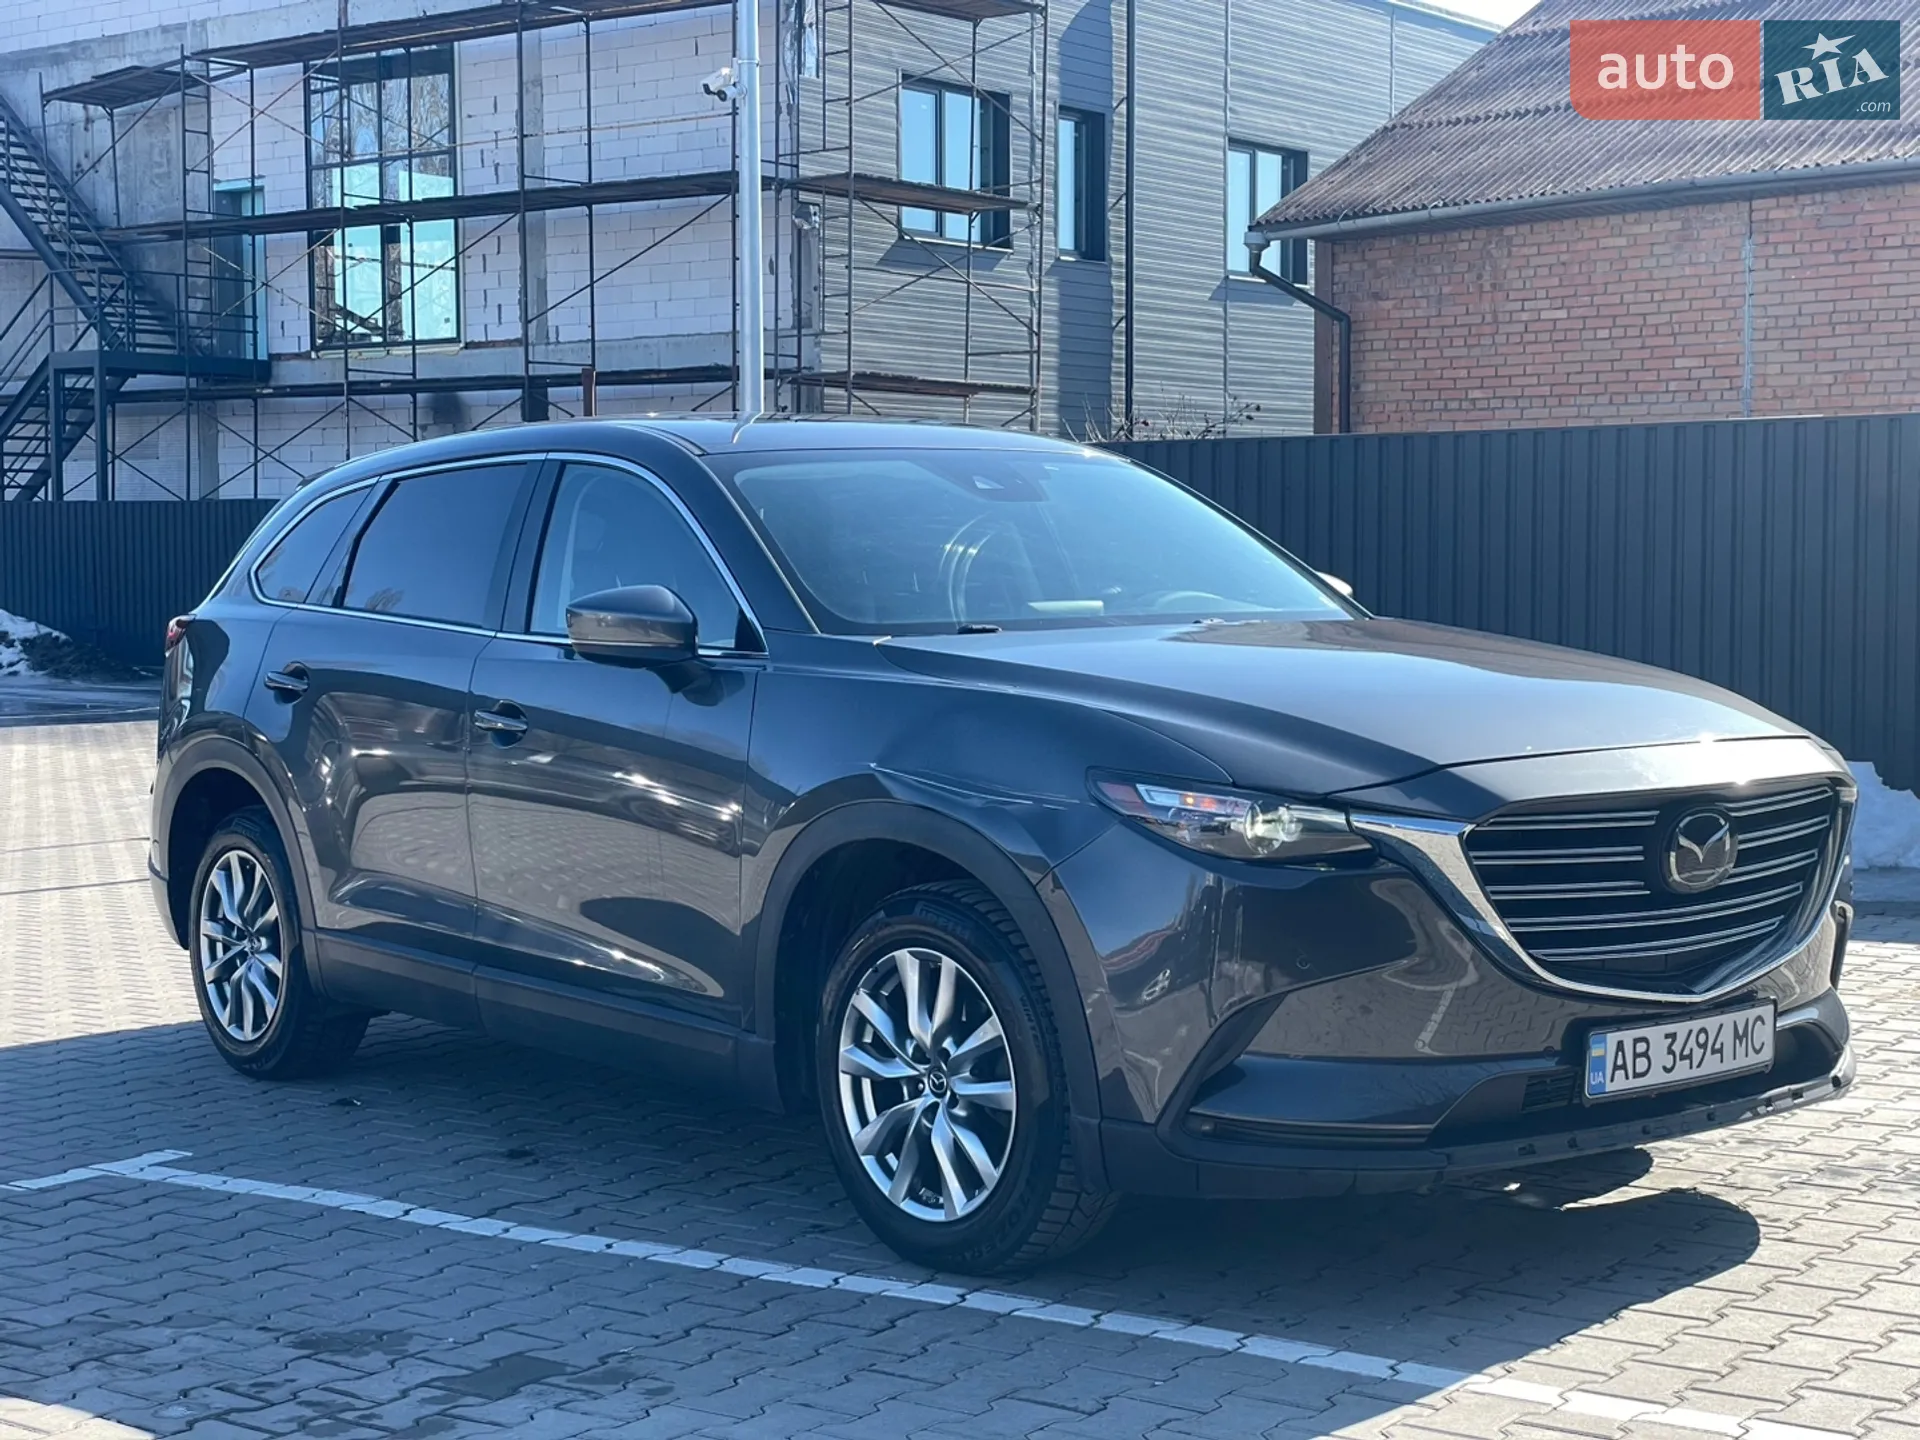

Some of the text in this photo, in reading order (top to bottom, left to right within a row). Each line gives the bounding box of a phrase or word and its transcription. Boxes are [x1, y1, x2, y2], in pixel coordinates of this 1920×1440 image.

[1610, 1015, 1765, 1083] AB 3494 MC
[1590, 1071, 1604, 1085] UA
